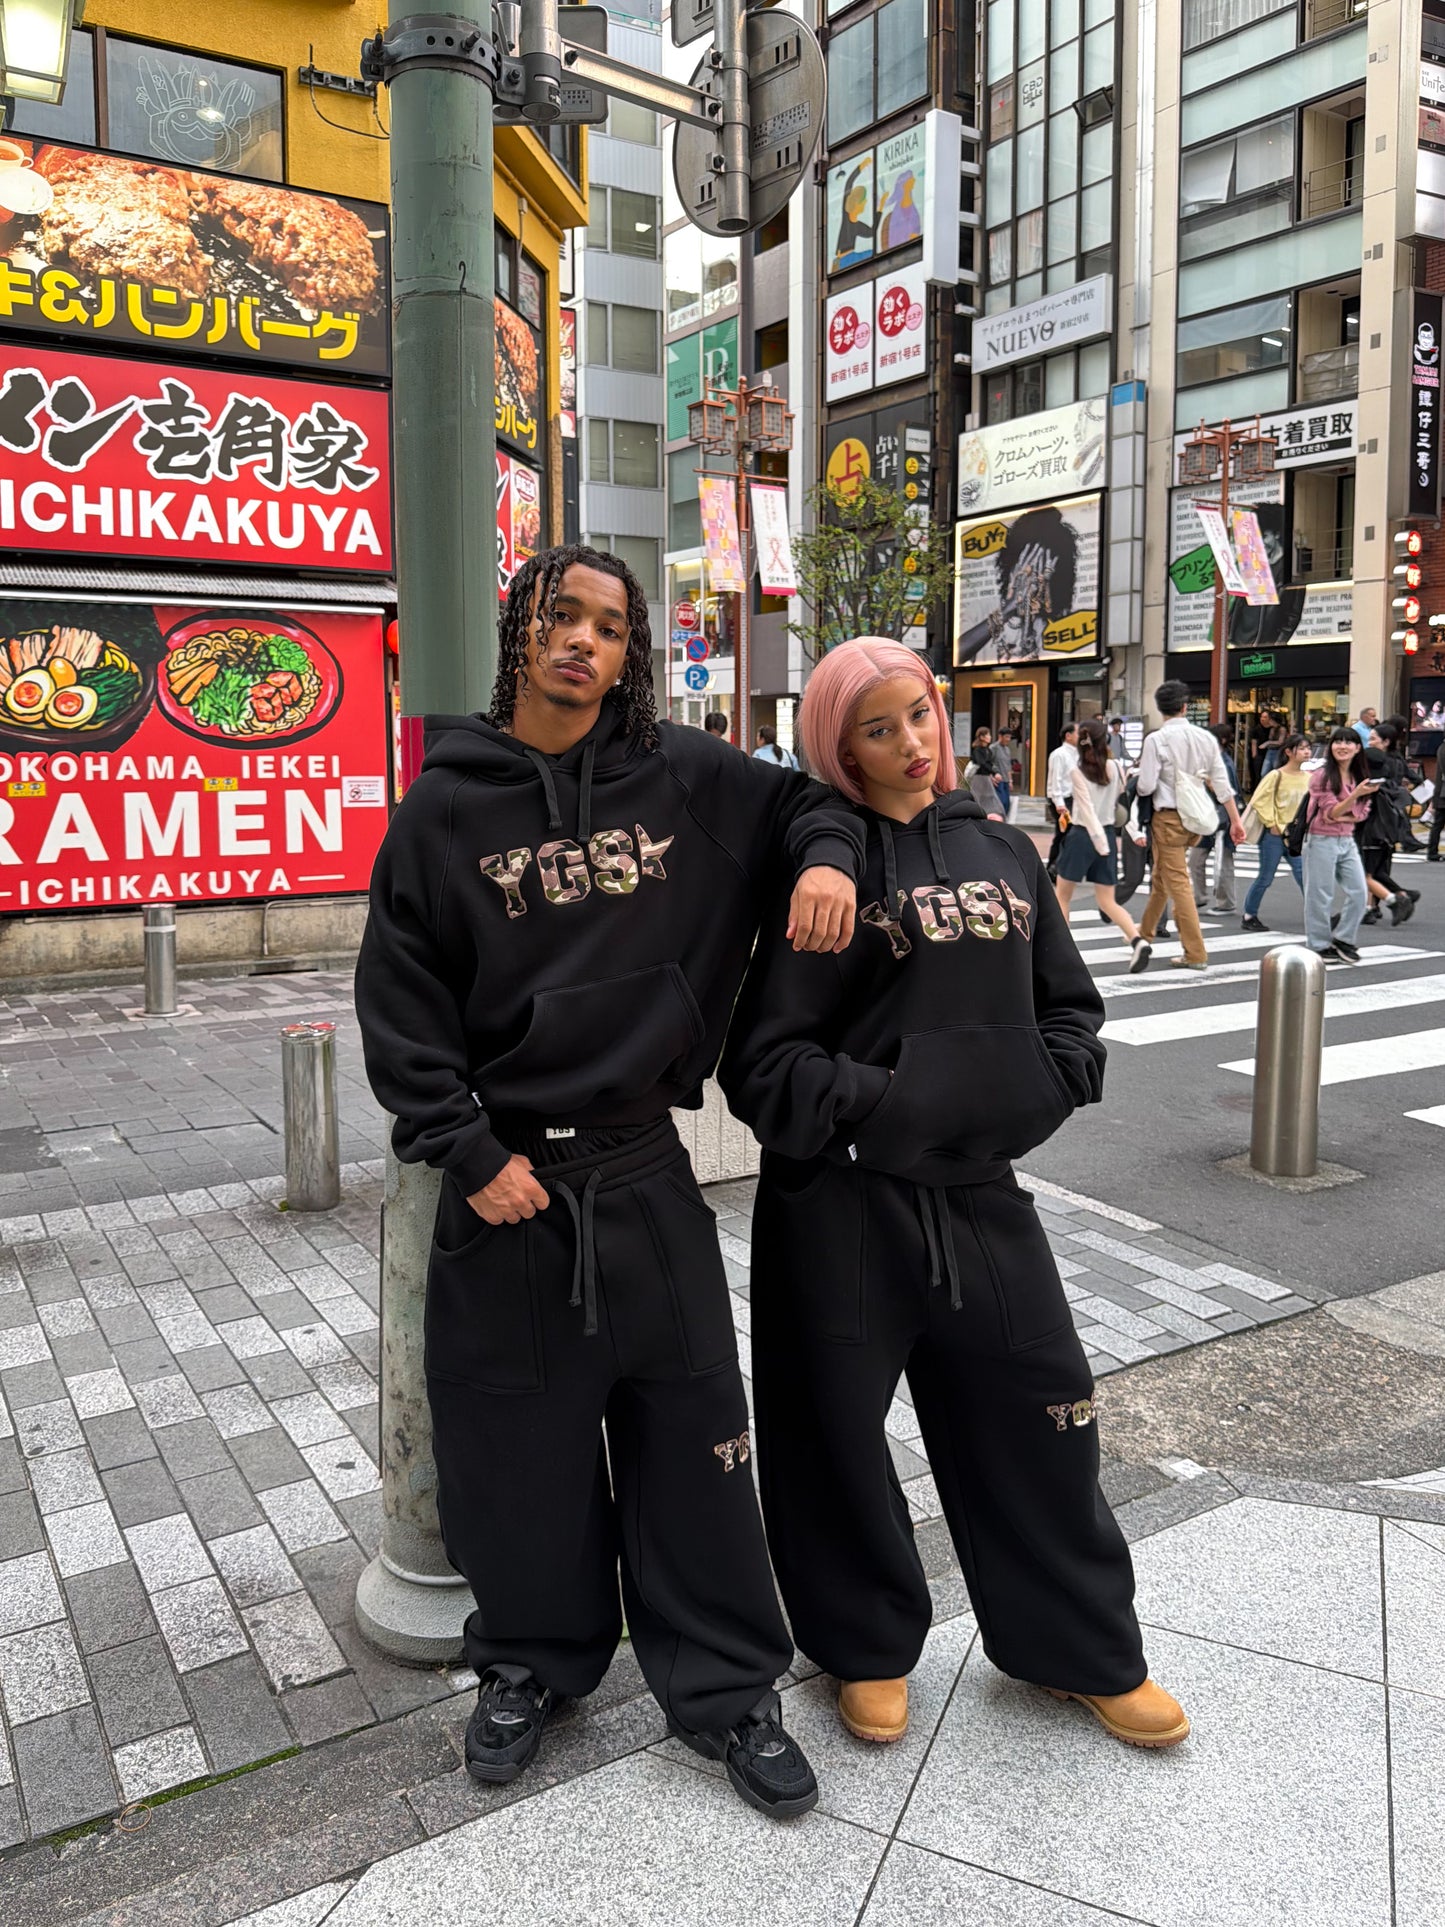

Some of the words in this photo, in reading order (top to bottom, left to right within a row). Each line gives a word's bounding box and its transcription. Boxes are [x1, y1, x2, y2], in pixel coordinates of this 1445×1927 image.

[884, 132, 919, 163] KIRIKA
[987, 320, 1057, 360] NUEVO
[993, 456, 1067, 487] ゴローズ買取
[0, 479, 384, 556] ICHIKAKUYA
[964, 527, 1004, 553] BUY?
[689, 670, 700, 687] P
[242, 755, 340, 780] IEKEI
[20, 868, 291, 905] ICHIKAKUYA
[479, 829, 640, 919] YGS
